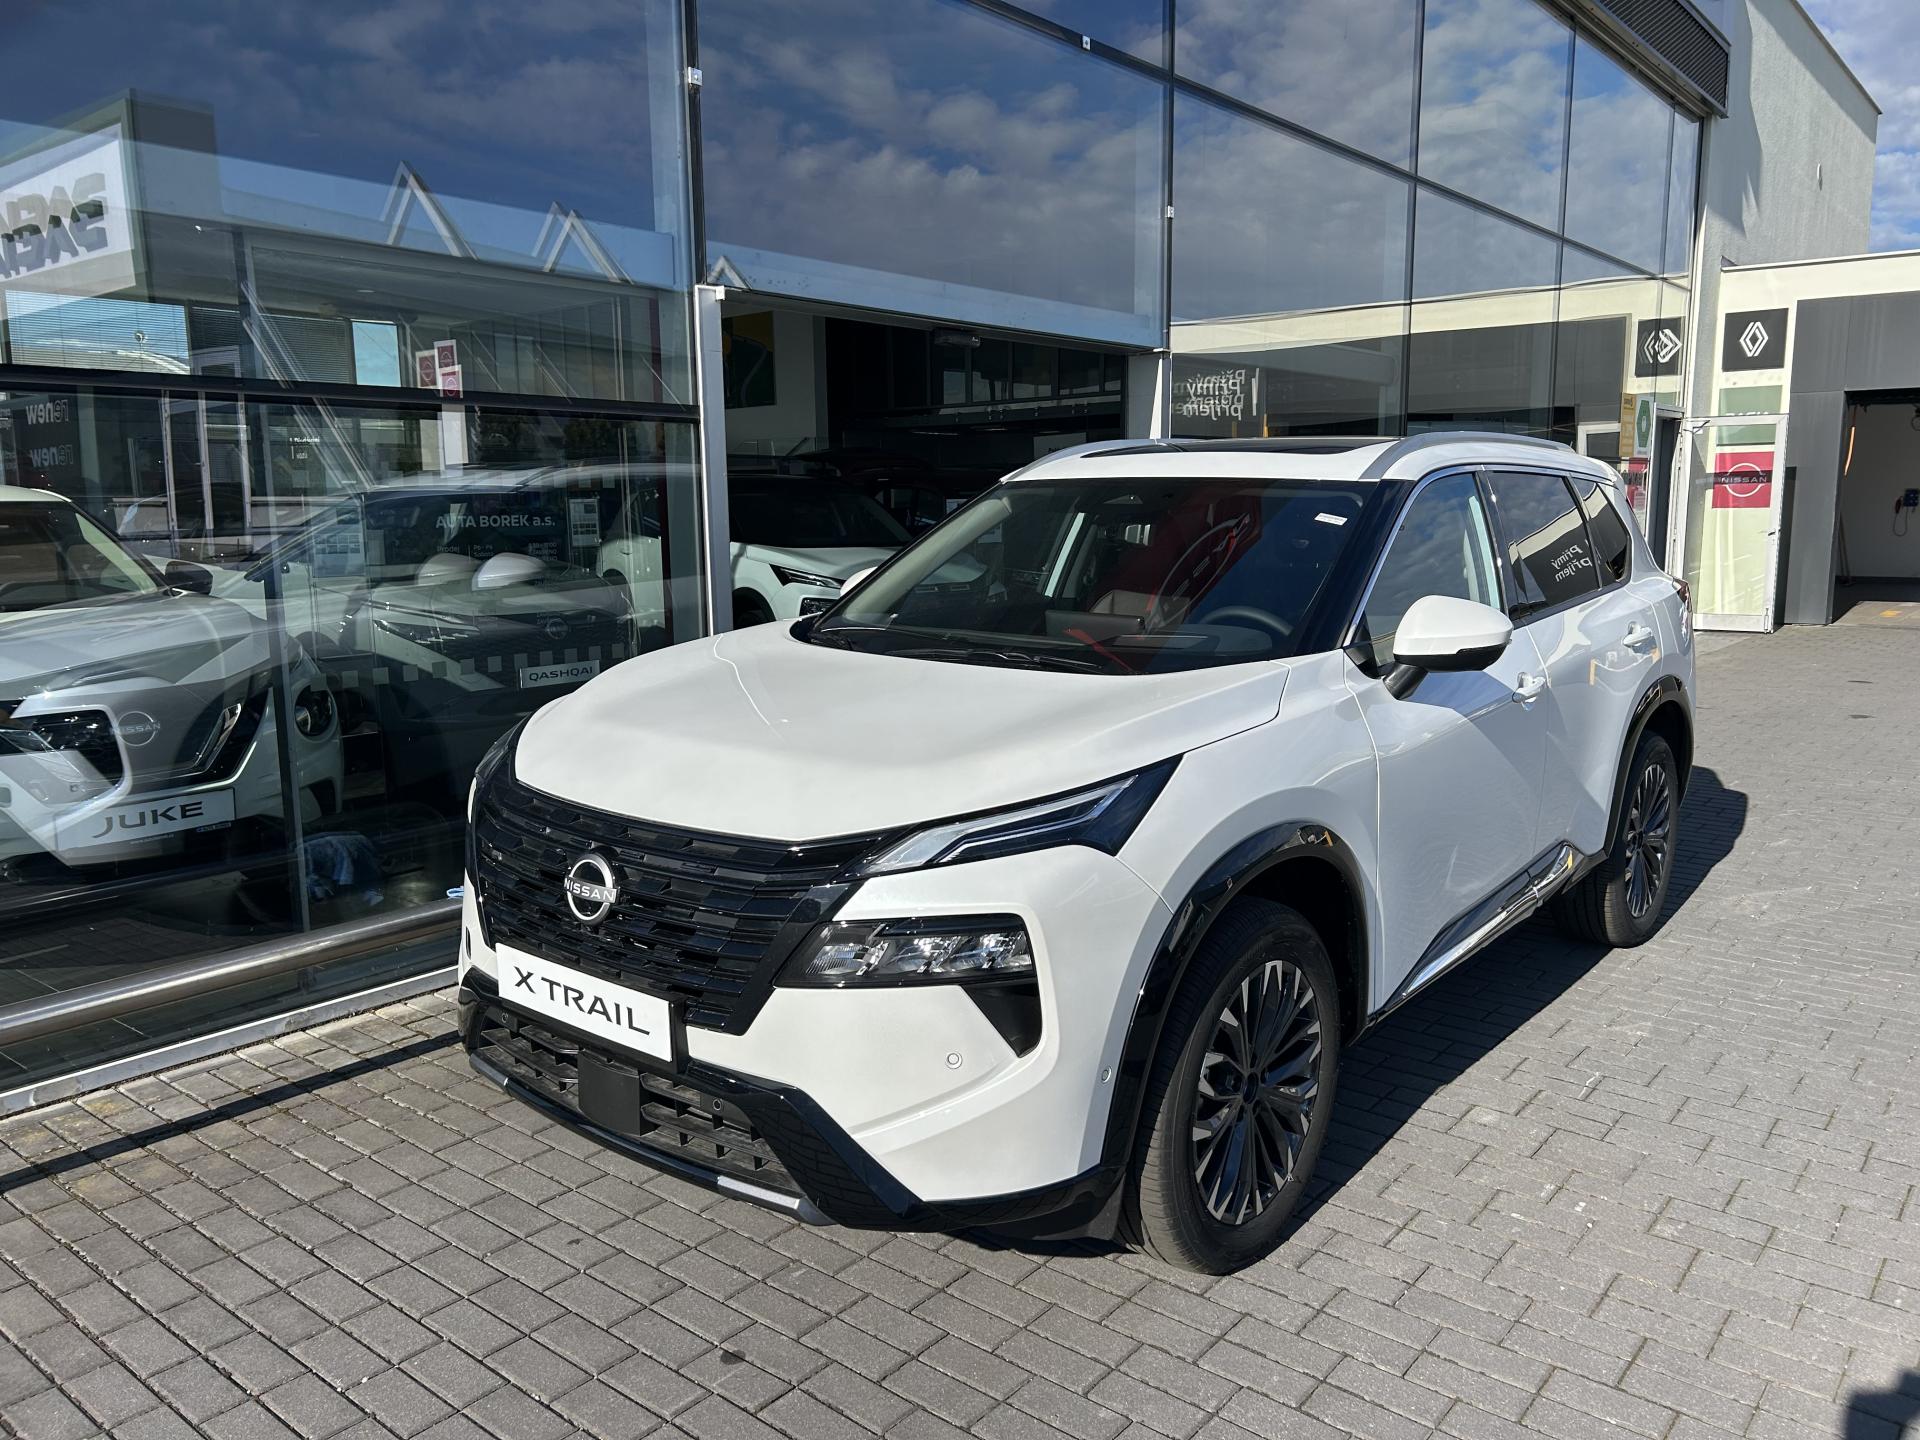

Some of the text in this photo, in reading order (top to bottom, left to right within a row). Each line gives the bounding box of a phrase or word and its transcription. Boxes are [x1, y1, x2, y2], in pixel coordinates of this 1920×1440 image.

[1721, 476, 1767, 484] NISSAN
[435, 514, 556, 529] AUTA BOREK a.s.
[529, 666, 593, 681] QASHQAI
[93, 801, 205, 838] JUKE
[563, 877, 615, 901] NISSAN
[514, 965, 651, 1036] X TRAIL
